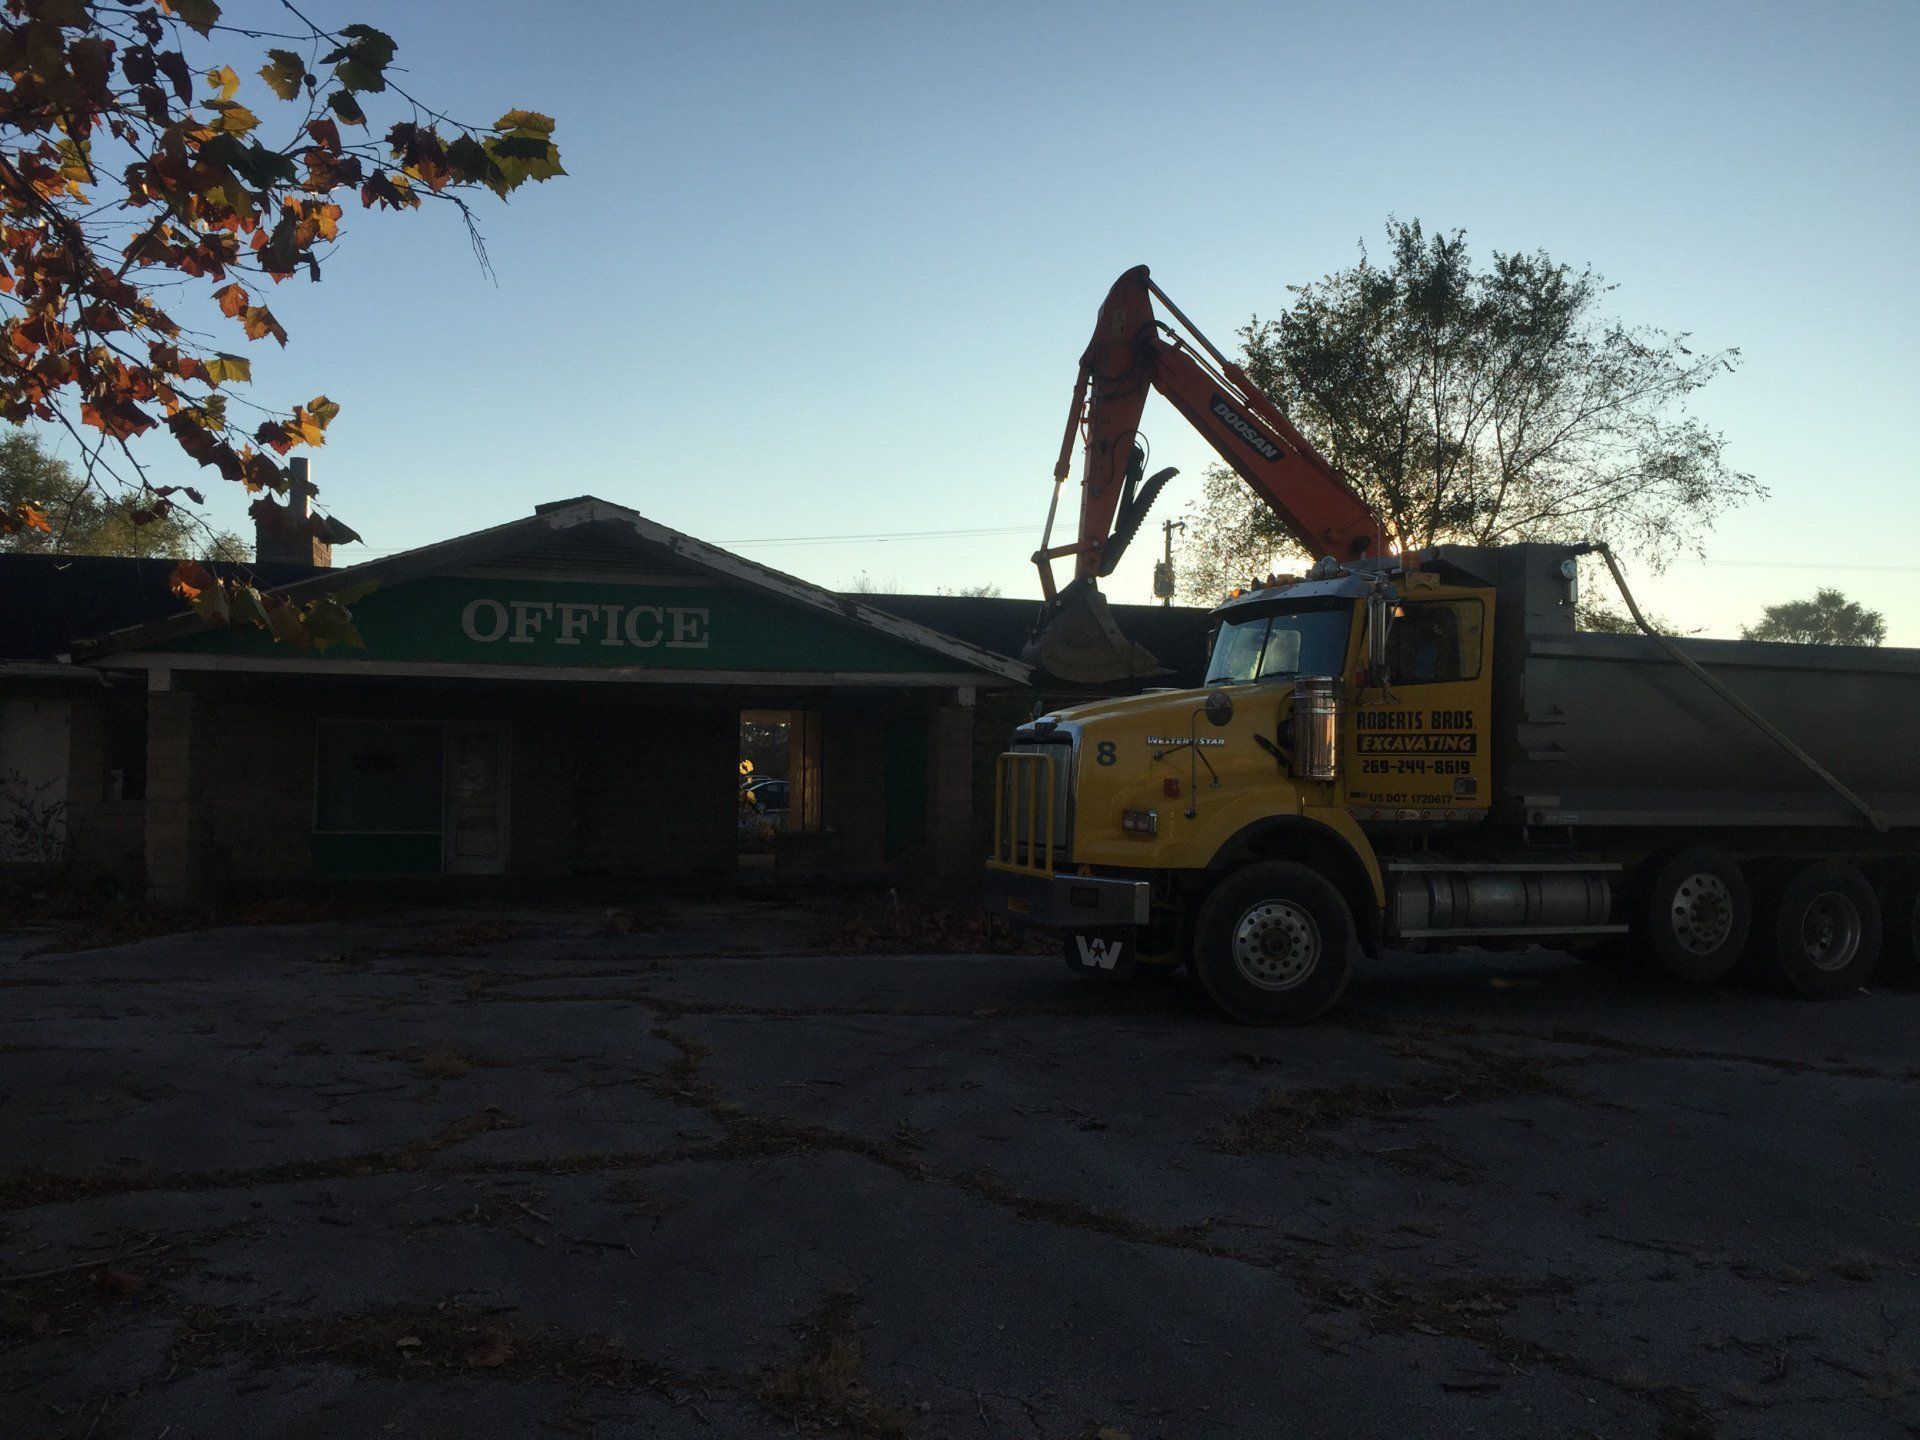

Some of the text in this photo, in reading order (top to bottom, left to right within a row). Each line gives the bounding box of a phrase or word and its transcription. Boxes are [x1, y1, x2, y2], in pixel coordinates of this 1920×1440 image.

[1213, 403, 1277, 457] DOOSAN
[461, 599, 709, 648] OFFICE
[1357, 711, 1477, 730] ROBERTS BROS.
[1199, 737, 1225, 746] STAR
[1362, 736, 1471, 751] EXCAVATING
[1097, 741, 1117, 766] 8
[1363, 760, 1470, 774] 269-244-8619
[1370, 794, 1384, 803] US
[1387, 794, 1407, 803] DOT
